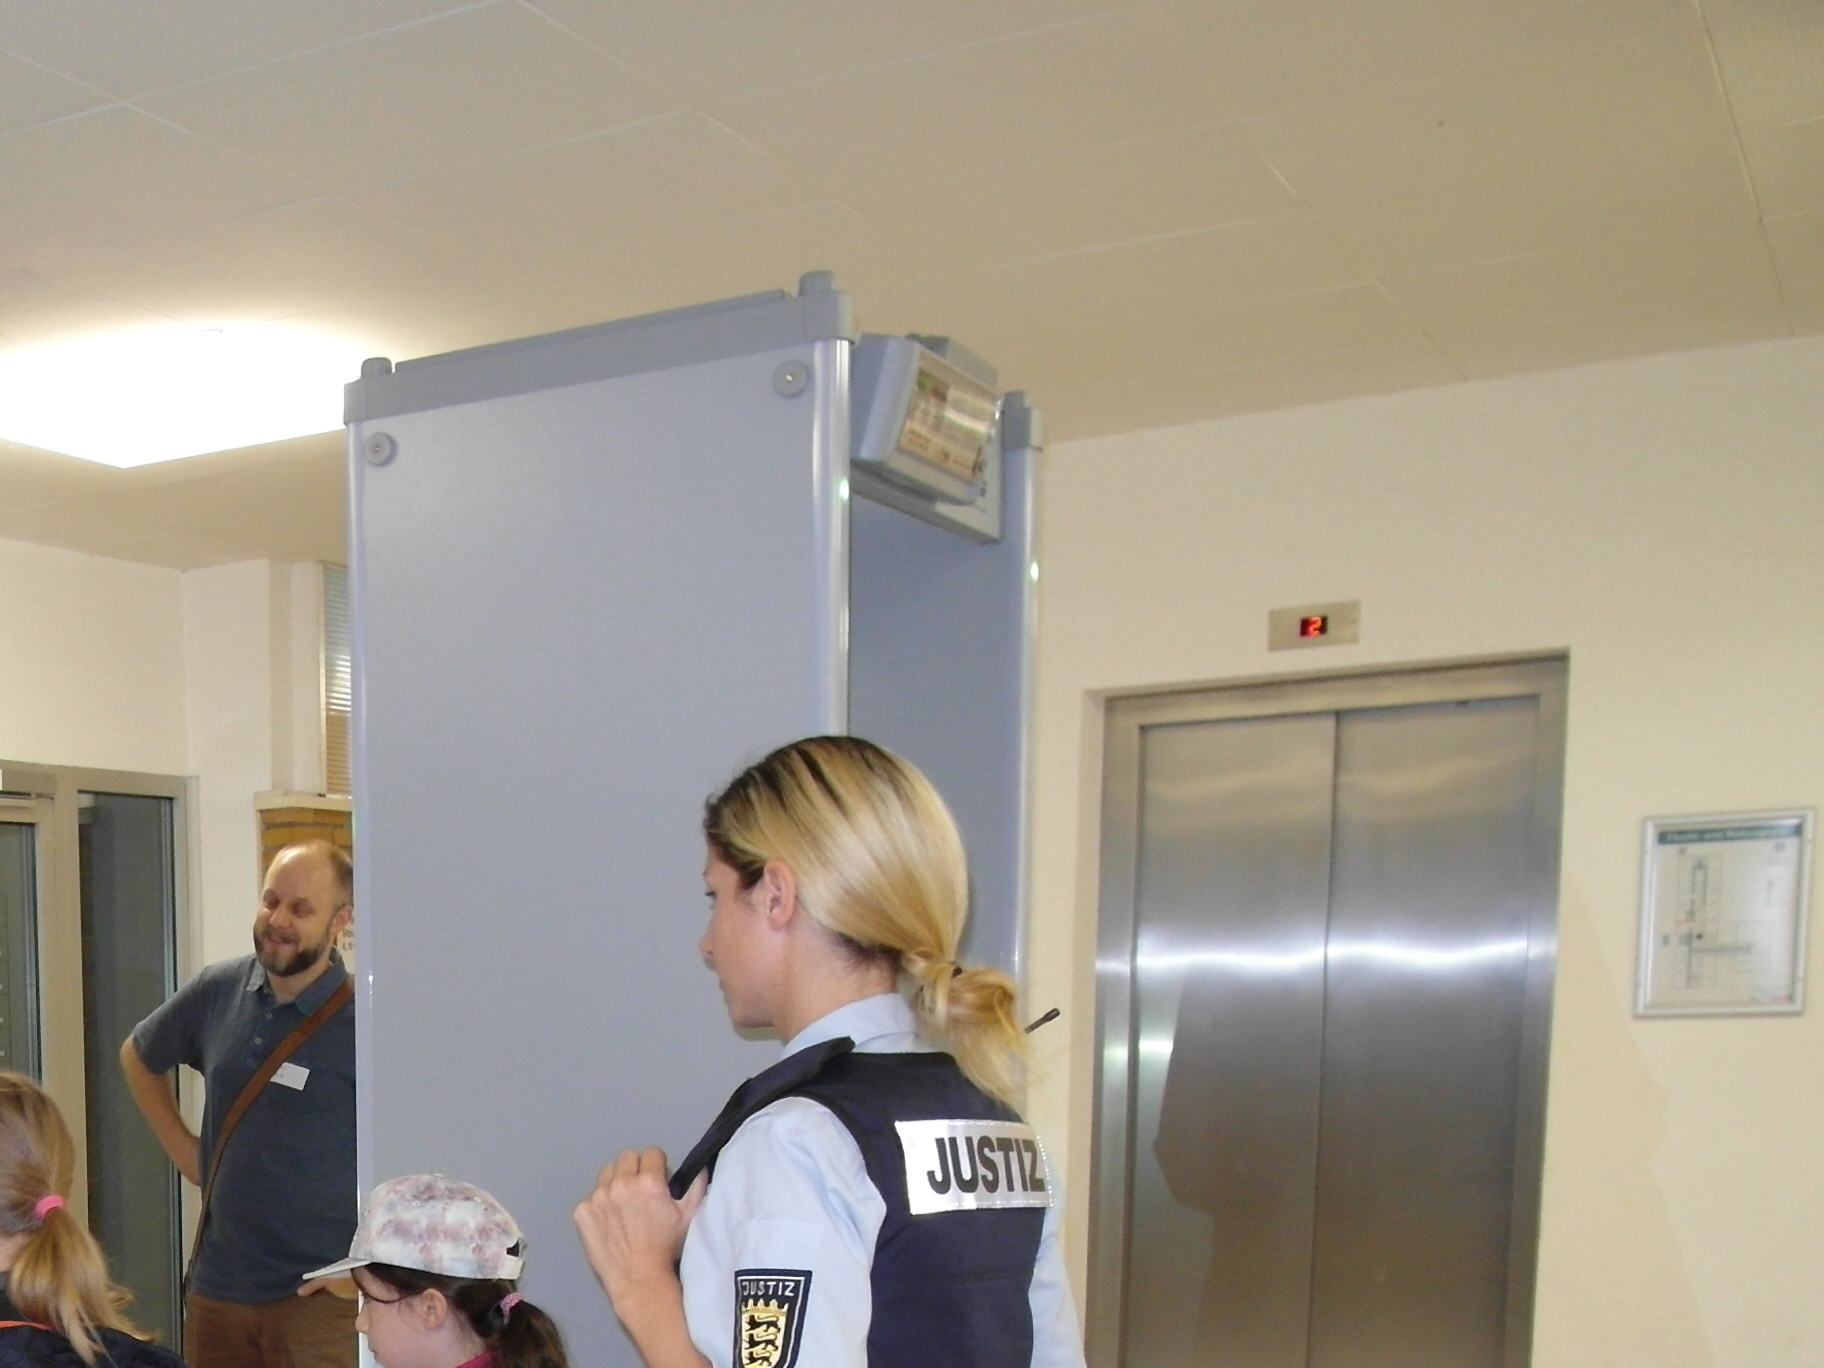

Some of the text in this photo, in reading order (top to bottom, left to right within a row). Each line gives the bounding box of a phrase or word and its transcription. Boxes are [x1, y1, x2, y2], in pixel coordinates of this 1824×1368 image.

[1308, 616, 1322, 637] 2
[926, 1135, 1046, 1195] JUSTIZ
[742, 1281, 795, 1296] JUSTIZ
